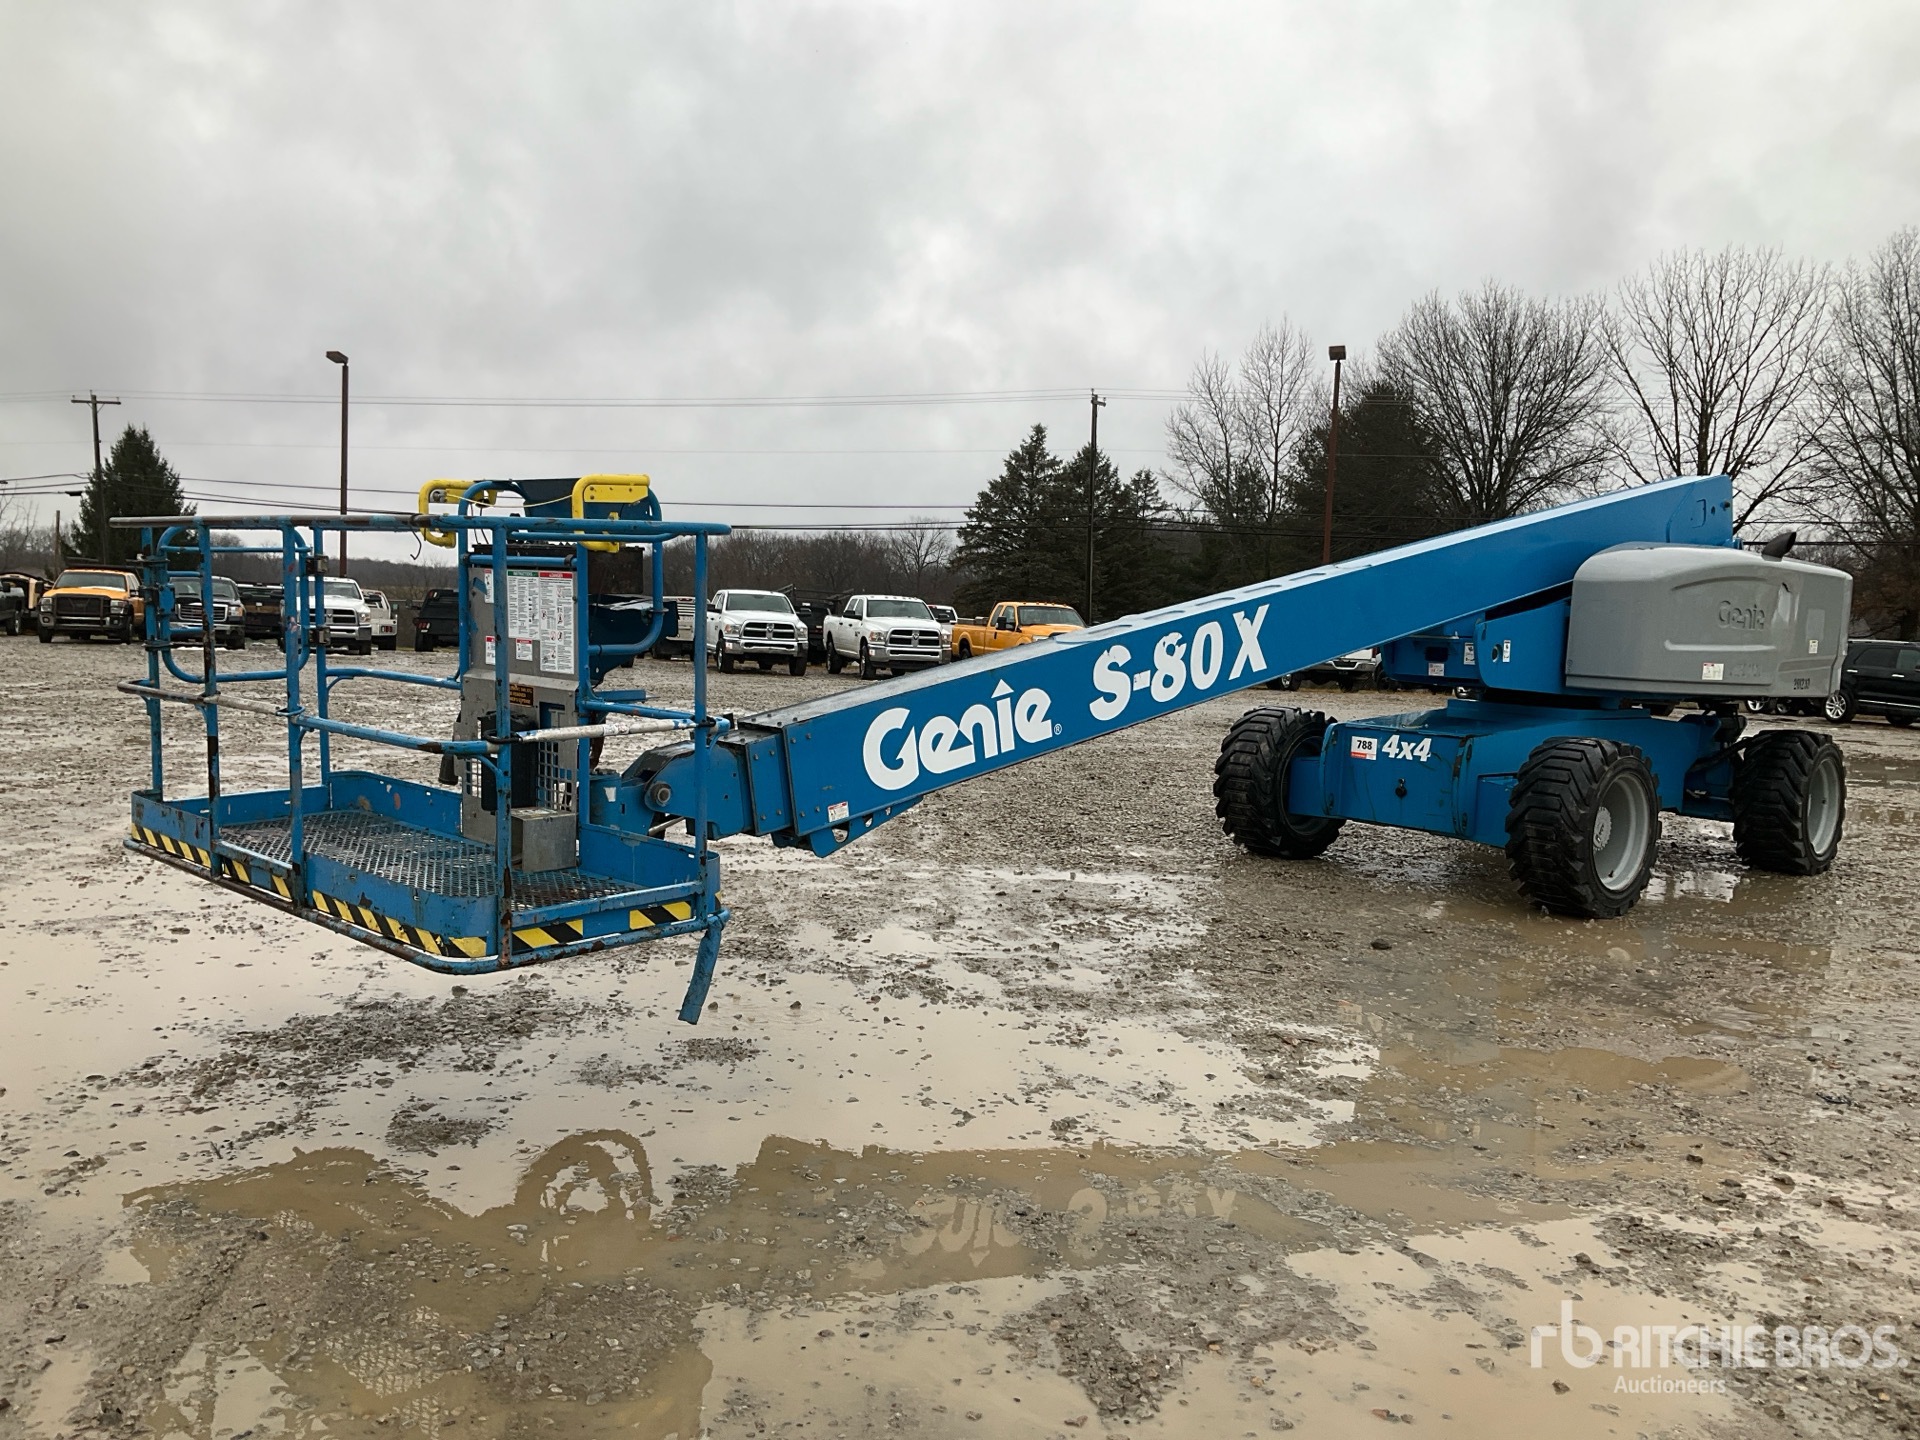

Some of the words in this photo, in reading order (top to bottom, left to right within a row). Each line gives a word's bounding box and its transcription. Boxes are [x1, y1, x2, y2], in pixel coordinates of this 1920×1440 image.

[1718, 600, 1766, 631] Genie
[863, 679, 1053, 791] Genie
[1356, 740, 1373, 751] 788
[1381, 734, 1433, 762] 4x4
